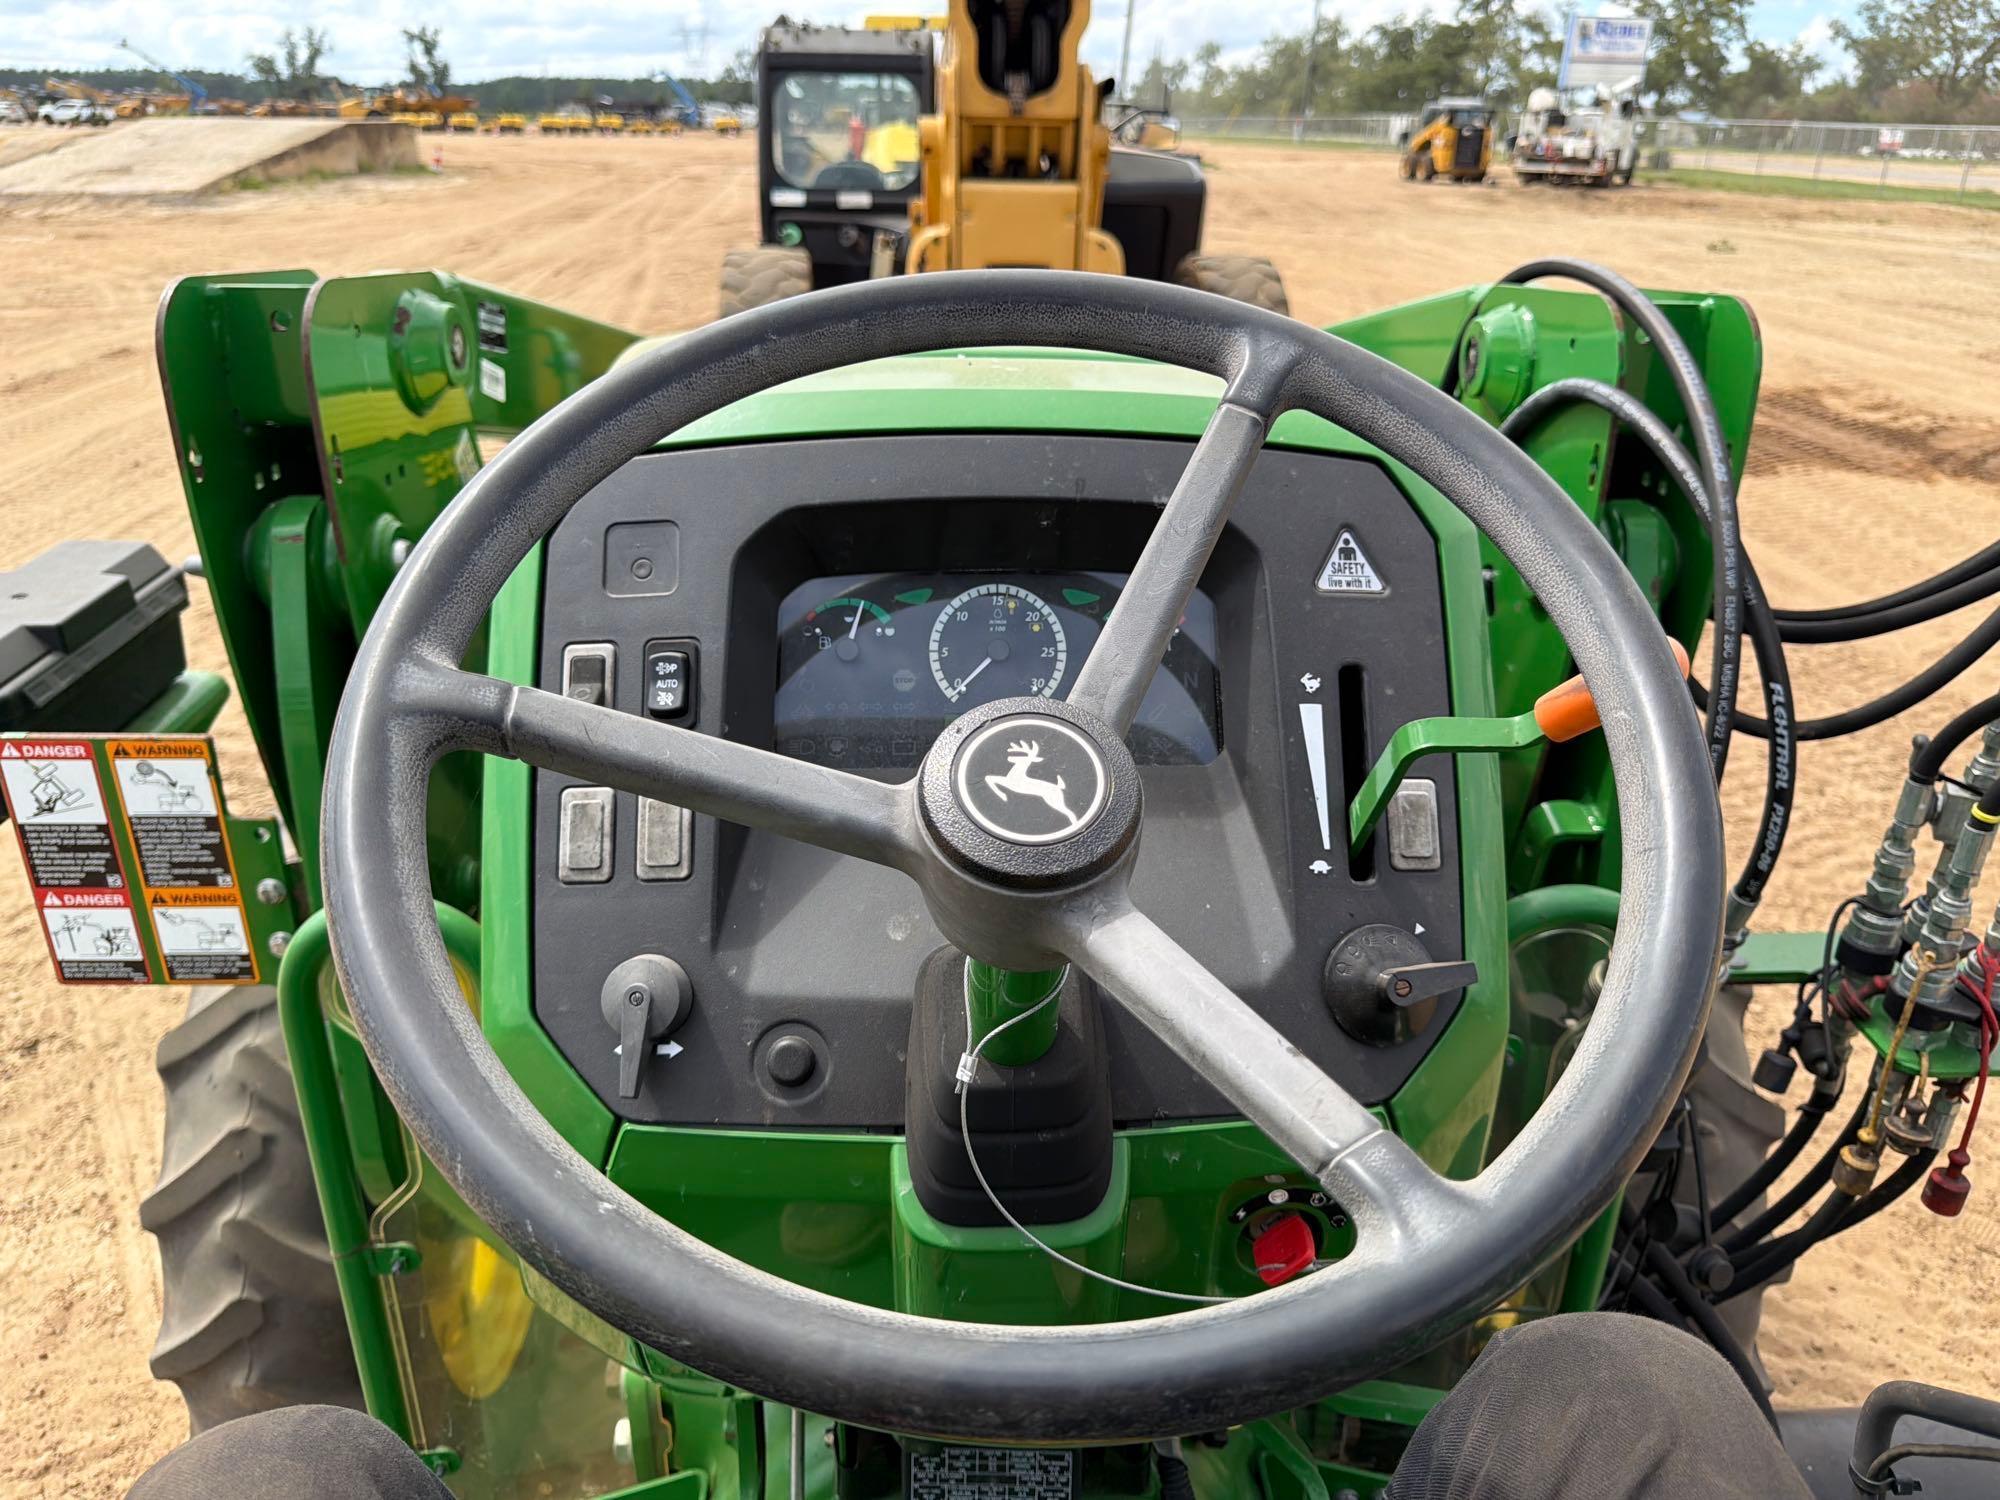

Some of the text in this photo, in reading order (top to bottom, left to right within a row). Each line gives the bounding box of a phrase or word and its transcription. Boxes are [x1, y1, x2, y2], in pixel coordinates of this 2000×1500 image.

[1331, 561, 1365, 575] SAFETY
[1327, 577, 1372, 588] live with it
[992, 595, 1004, 606] 15
[956, 611, 968, 622] 10
[1025, 611, 1040, 622] 20
[941, 647, 949, 657] 5
[1041, 647, 1055, 657] 25
[656, 679, 678, 689] AUTO
[954, 678, 961, 688] 0
[1031, 678, 1045, 688] 30
[22, 744, 87, 758] DANGER
[132, 744, 205, 757] WARNING
[1757, 681, 1789, 872] FLEXTRAL PX250-06
[63, 893, 125, 907] DANGER
[170, 892, 237, 904] WARNING
